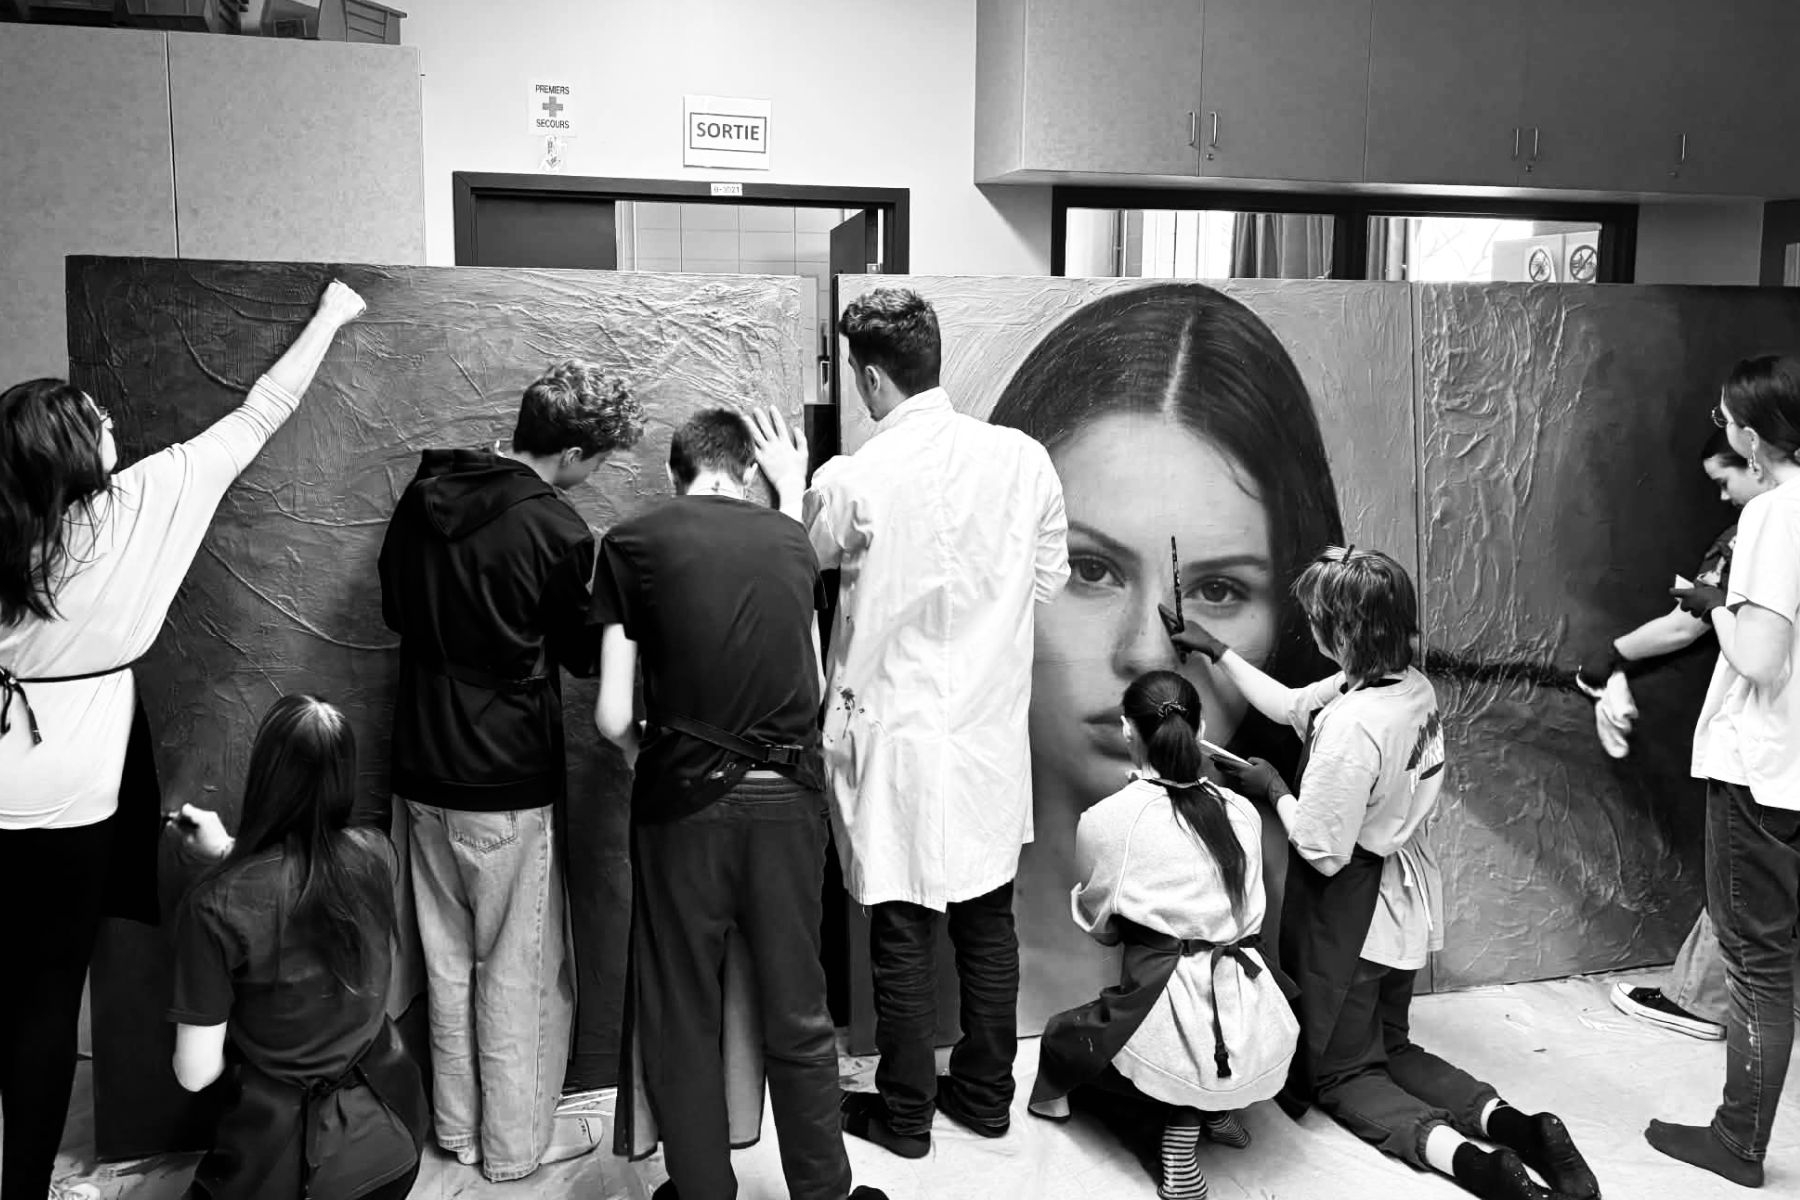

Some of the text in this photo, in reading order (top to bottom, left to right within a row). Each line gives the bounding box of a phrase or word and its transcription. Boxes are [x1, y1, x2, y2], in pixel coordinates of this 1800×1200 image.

[536, 85, 570, 95] PREMIERS
[536, 118, 570, 129] SECOURS
[697, 122, 760, 141] SORTIE
